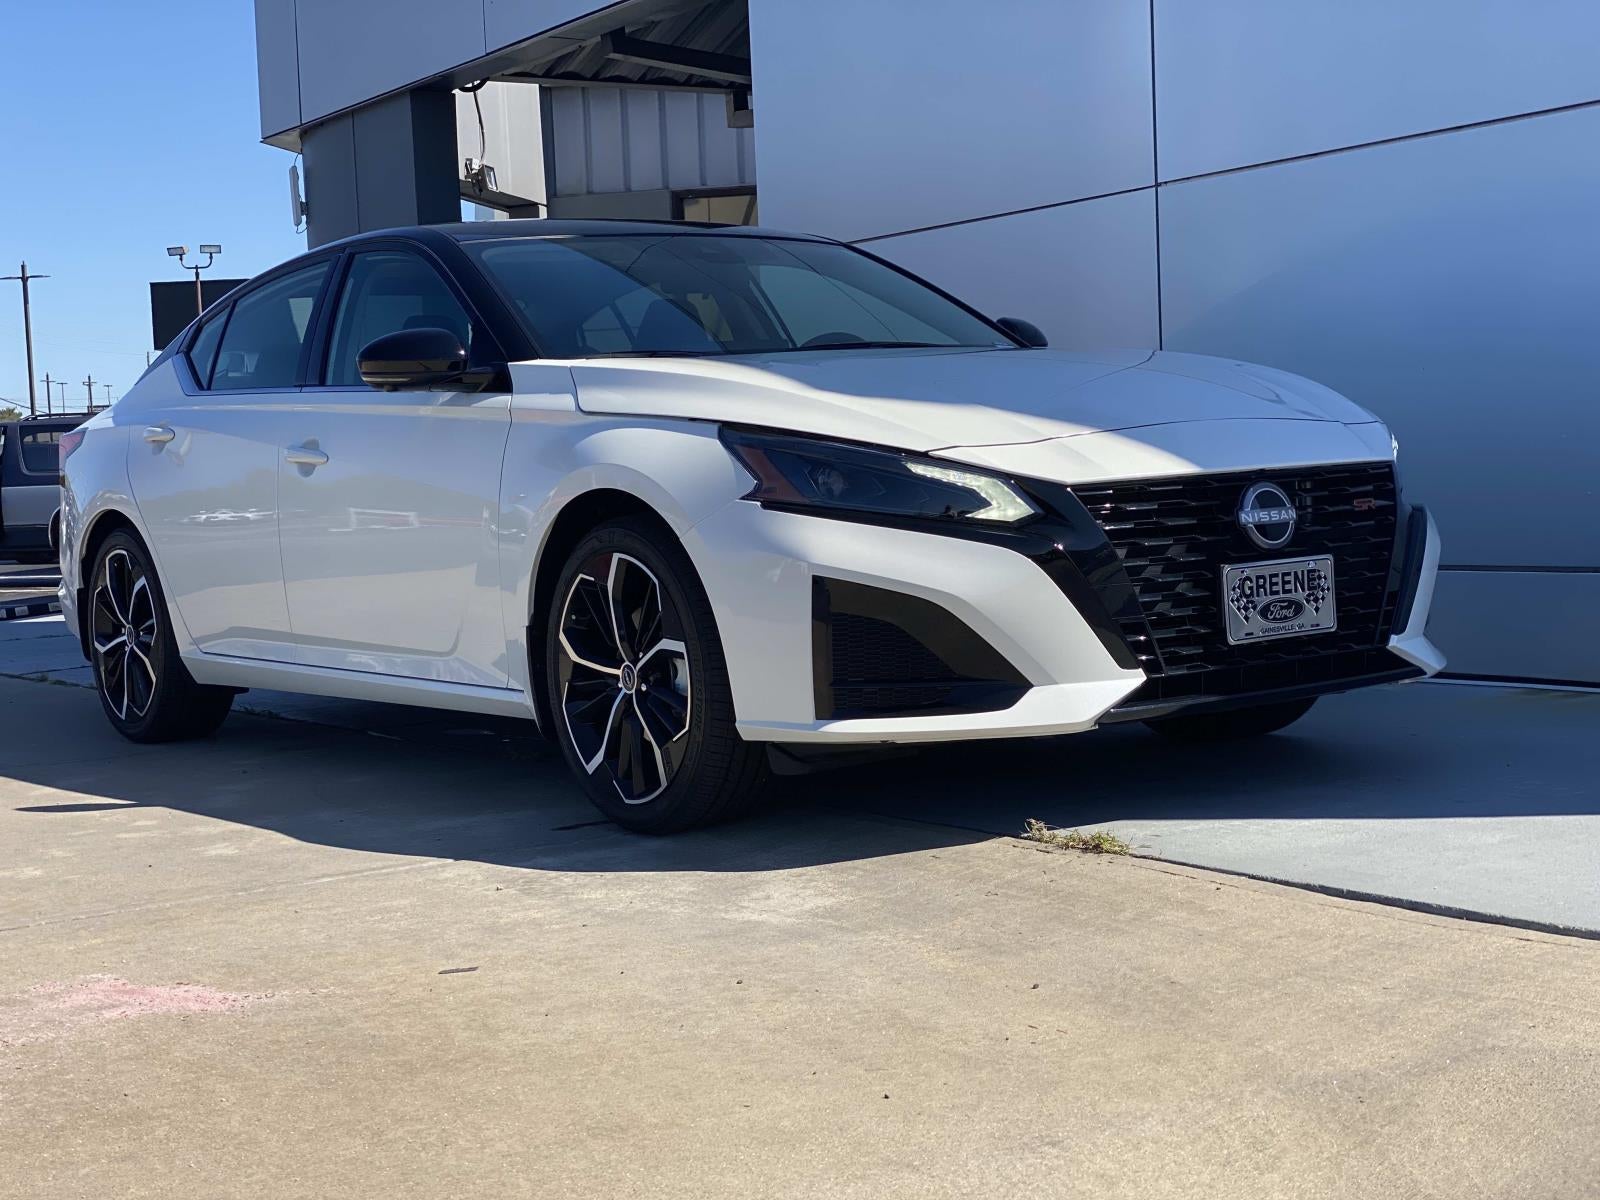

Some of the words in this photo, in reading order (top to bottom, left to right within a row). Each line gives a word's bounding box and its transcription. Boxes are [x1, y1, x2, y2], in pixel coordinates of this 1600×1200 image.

[1353, 497, 1376, 510] SR
[1241, 508, 1296, 523] NISSAN
[1240, 569, 1318, 599] GREENE
[1267, 602, 1295, 618] Ford
